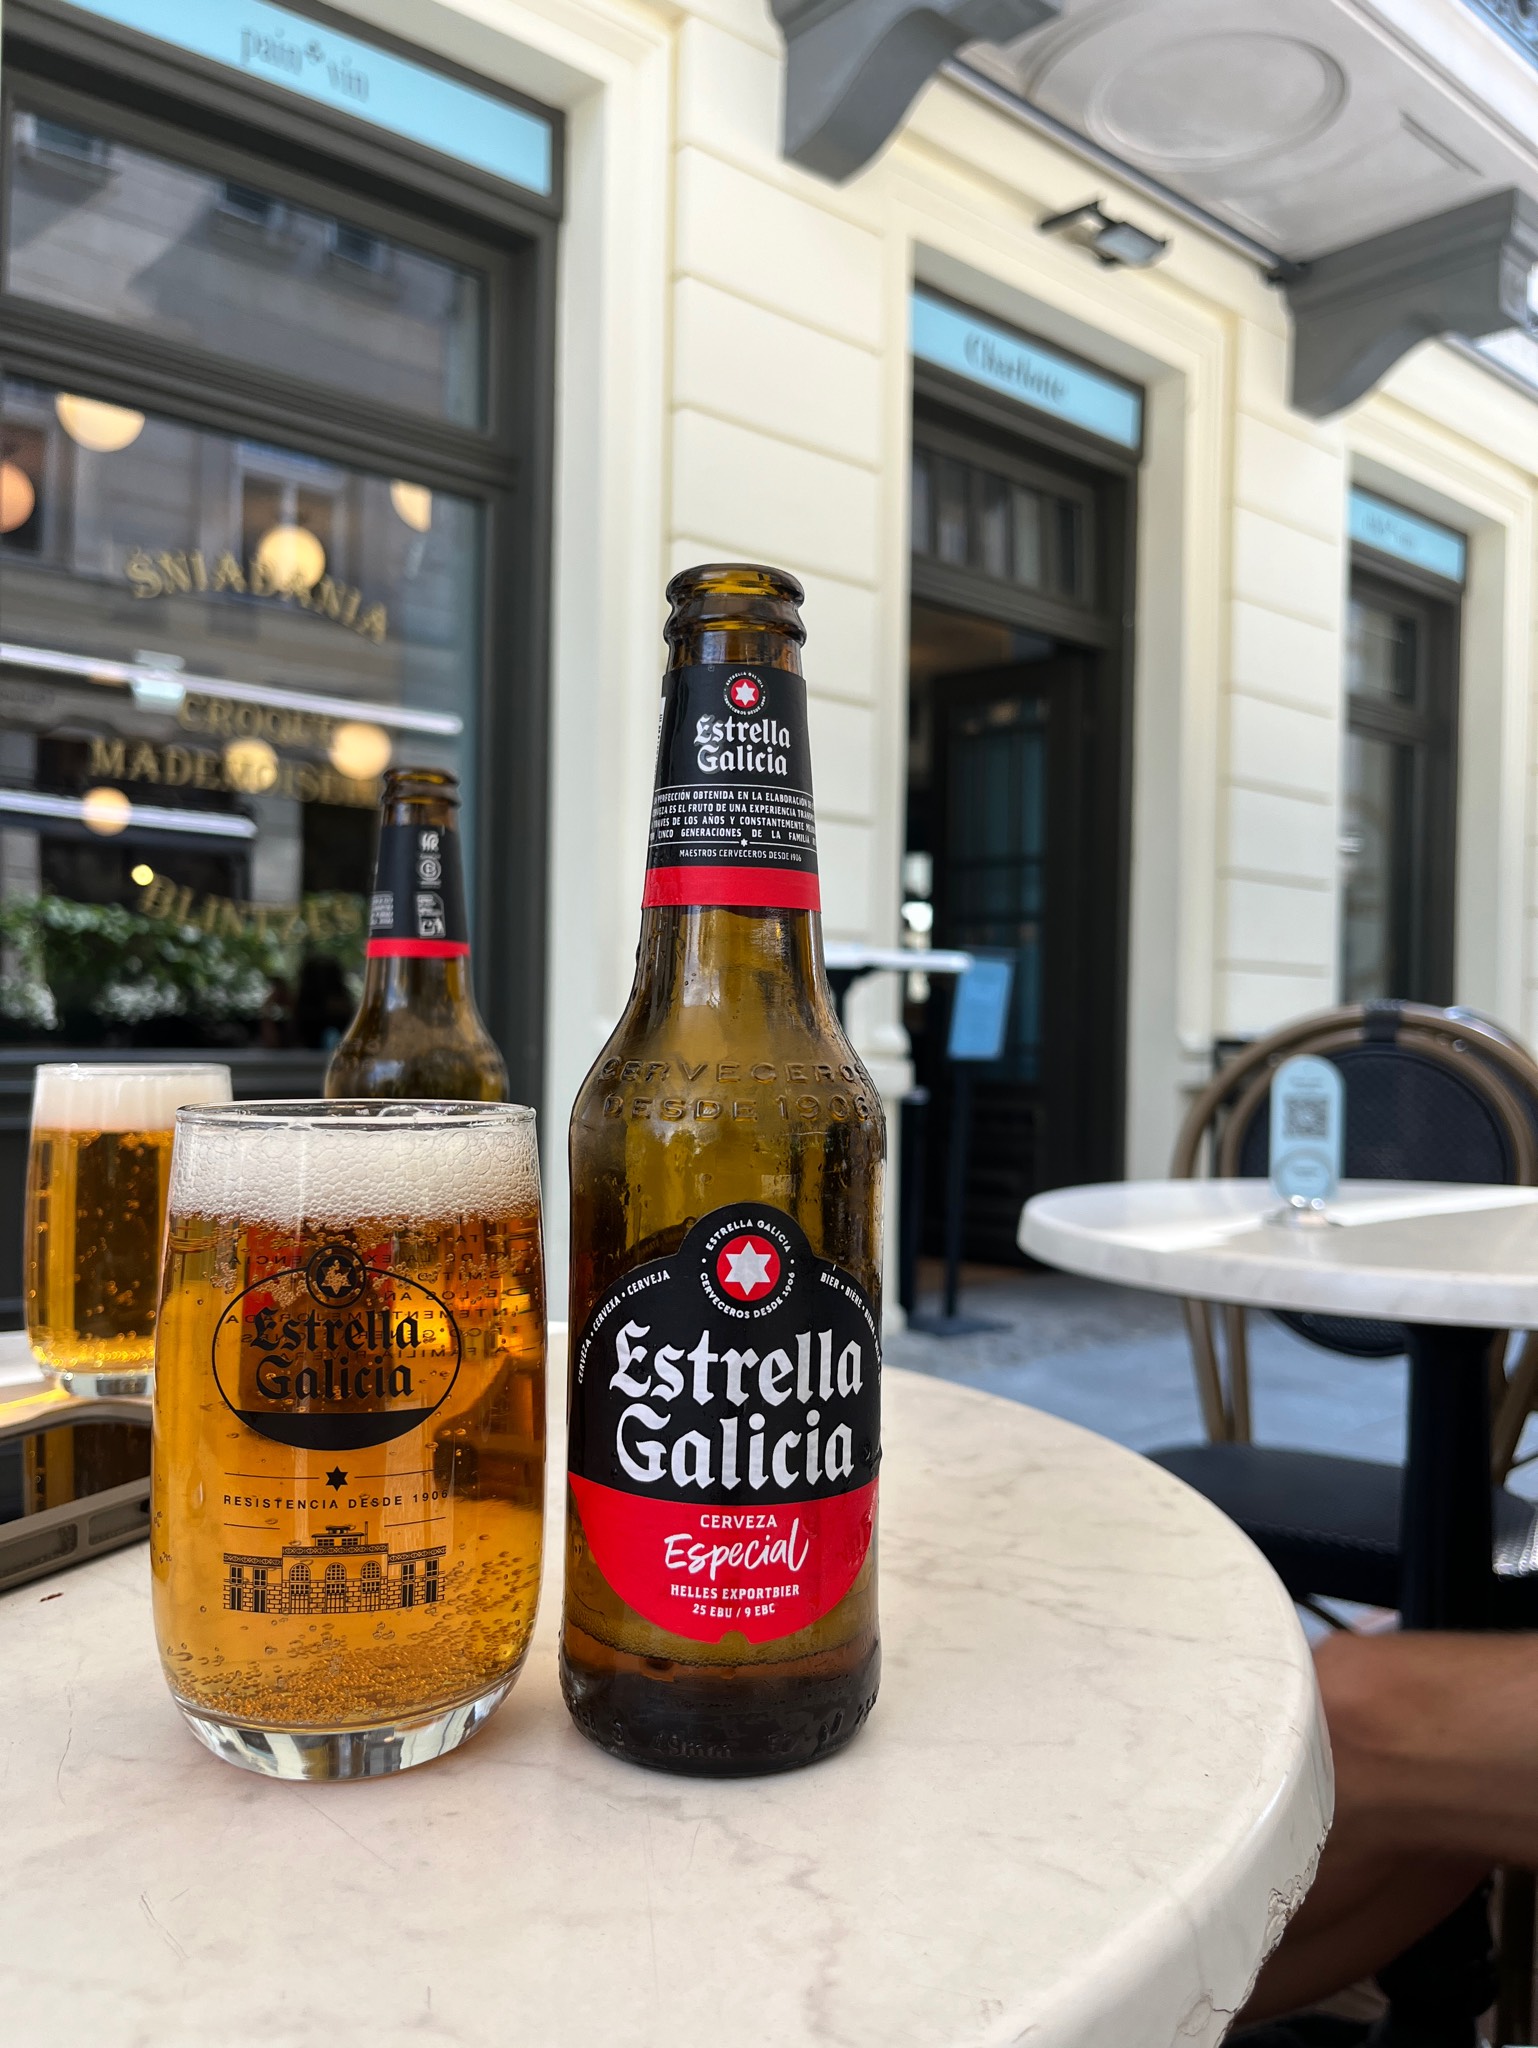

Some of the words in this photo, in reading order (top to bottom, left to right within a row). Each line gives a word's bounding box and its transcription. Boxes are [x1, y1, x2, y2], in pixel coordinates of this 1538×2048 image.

[694, 714, 791, 749] Estrella
[697, 744, 789, 776] Galicia
[693, 791, 734, 800] OBTENIDA
[738, 791, 749, 800] EN
[752, 791, 762, 800] LA
[669, 804, 677, 814] ES
[678, 804, 686, 813] EL
[688, 803, 714, 813] FRUTO
[716, 803, 727, 813] DE
[729, 803, 747, 813] UNA
[749, 804, 797, 817] EXPERIENCIA
[672, 816, 681, 826] DE
[684, 816, 698, 825] LOS
[702, 813, 725, 825] AÑOS
[729, 816, 735, 825] Y
[739, 816, 805, 831] CONSTANTEMENTE
[681, 828, 742, 837] GENERACIONES
[751, 828, 762, 838] DE
[771, 830, 781, 840] LA
[679, 849, 717, 858] MAESTROS
[719, 849, 767, 859] CERVECEROS
[768, 851, 789, 860] DESDE
[600, 1056, 868, 1084] CERVECEROS
[603, 1093, 758, 1122] DESDE
[776, 1094, 870, 1122] 1906
[705, 1219, 753, 1251] ESTRELLA
[757, 1220, 791, 1253] GALICIA
[820, 1272, 839, 1290] BIER
[700, 1272, 750, 1319] CERVECEROS
[753, 1296, 783, 1319] DESDE
[782, 1272, 795, 1297] 1906
[250, 1306, 423, 1352] Estrella
[578, 1338, 592, 1384] CERVEZA
[592, 1295, 621, 1332] CERVEXA
[627, 1270, 671, 1296] CERVEJA
[609, 1319, 864, 1406] Estrella
[255, 1354, 415, 1401] Galicia
[615, 1403, 855, 1491] Galicia
[223, 1494, 339, 1510] RESISTENCIA
[348, 1494, 404, 1510] DESDE
[412, 1489, 449, 1504] 1906
[699, 1513, 778, 1530] CERVEZA
[664, 1516, 810, 1581] Especial
[670, 1583, 718, 1600] HELLES
[722, 1583, 800, 1601] EXPORTBIER
[692, 1602, 707, 1617] 25
[709, 1604, 733, 1618] EBU
[743, 1605, 751, 1618] 9
[754, 1602, 776, 1617] EBC
